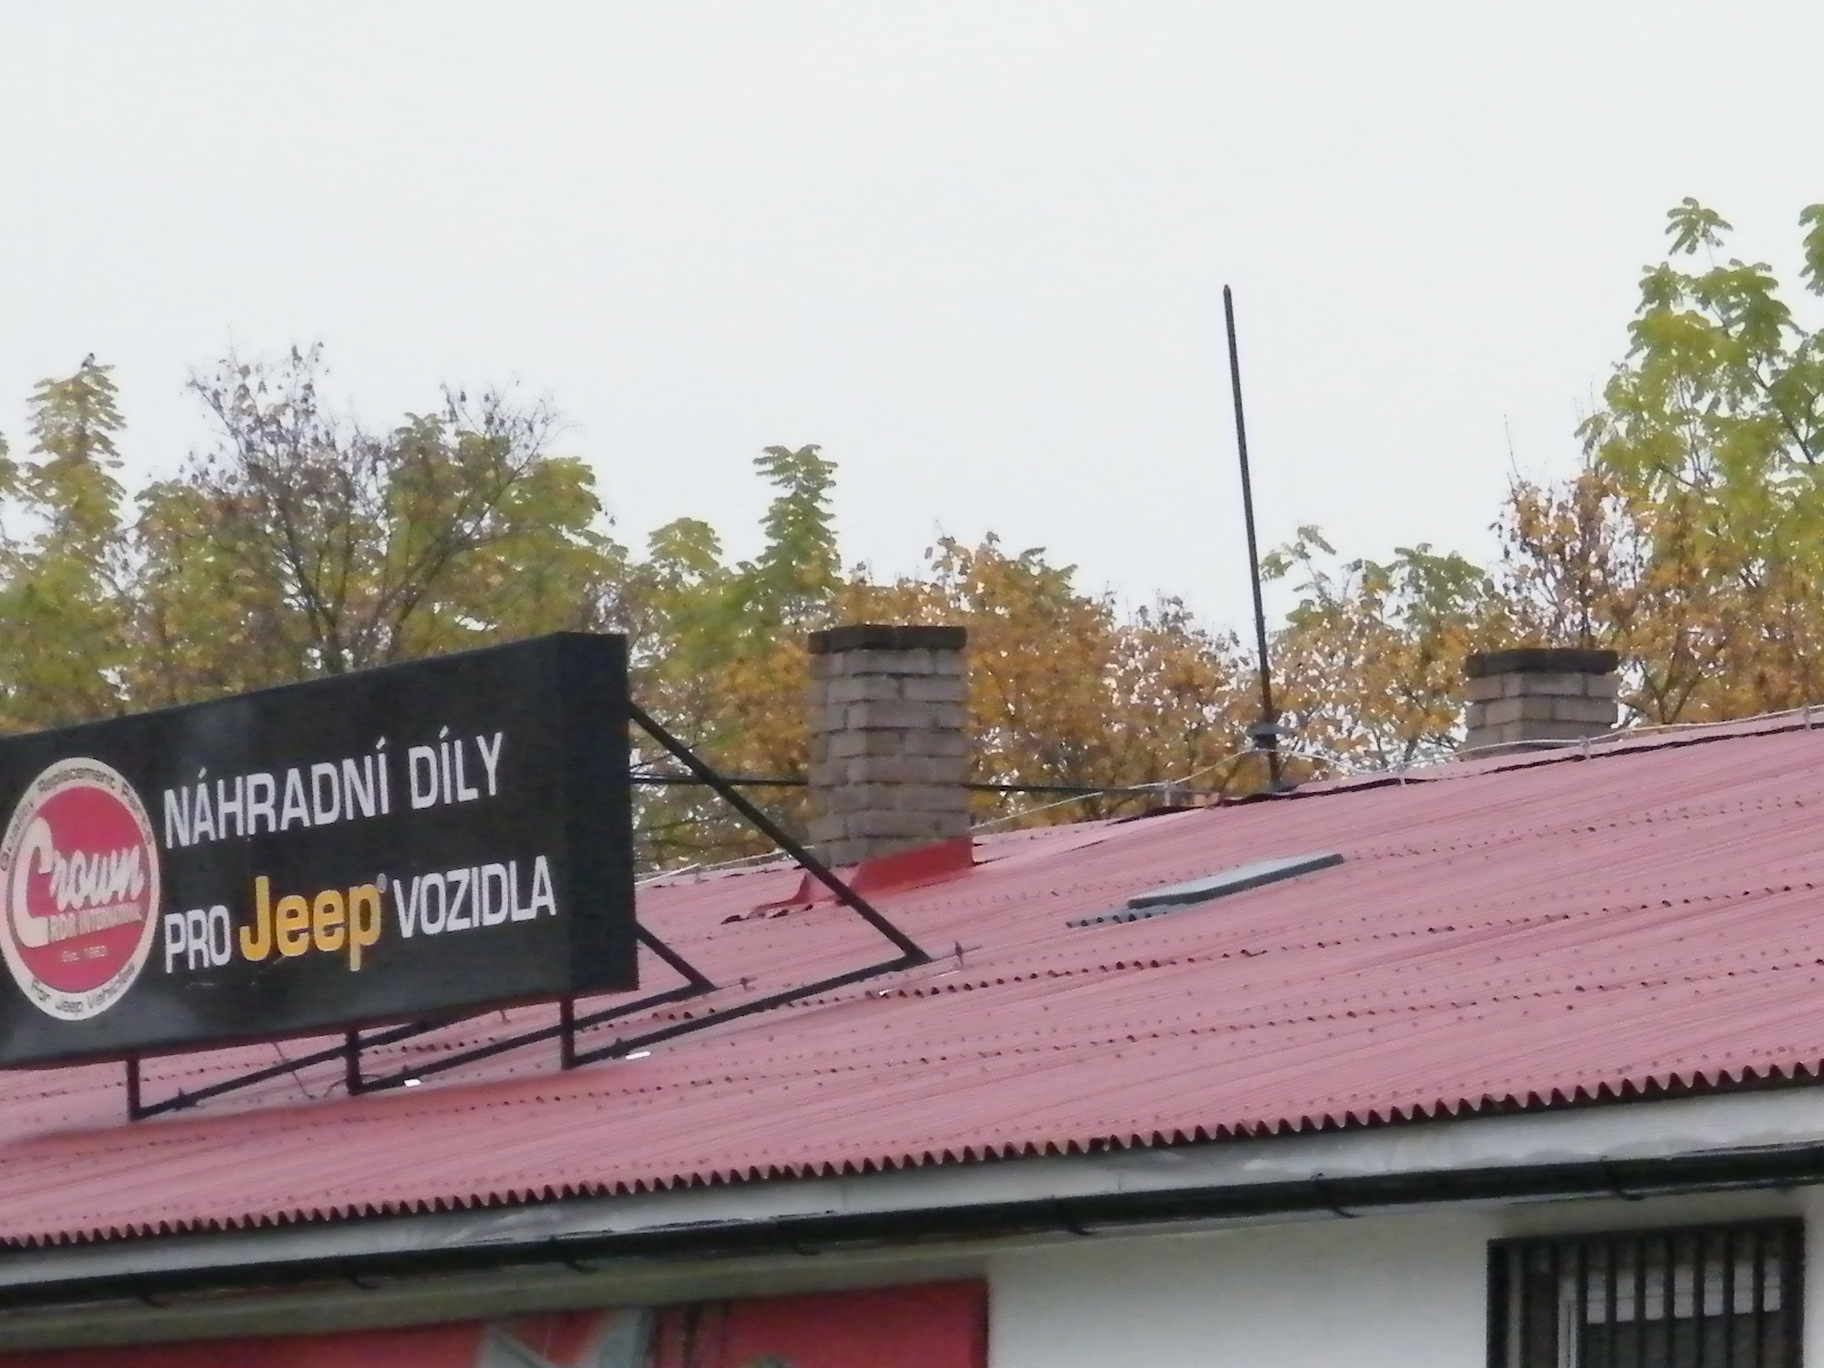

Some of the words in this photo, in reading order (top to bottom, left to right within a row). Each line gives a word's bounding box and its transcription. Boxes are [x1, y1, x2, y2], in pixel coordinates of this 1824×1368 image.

[164, 737, 389, 849] NÁHRADNÍ
[408, 725, 503, 809] DÍLY
[13, 817, 144, 948] Crown
[165, 905, 231, 974] PRO
[240, 876, 383, 972] Jeep
[394, 855, 557, 940] VOZIDLA
